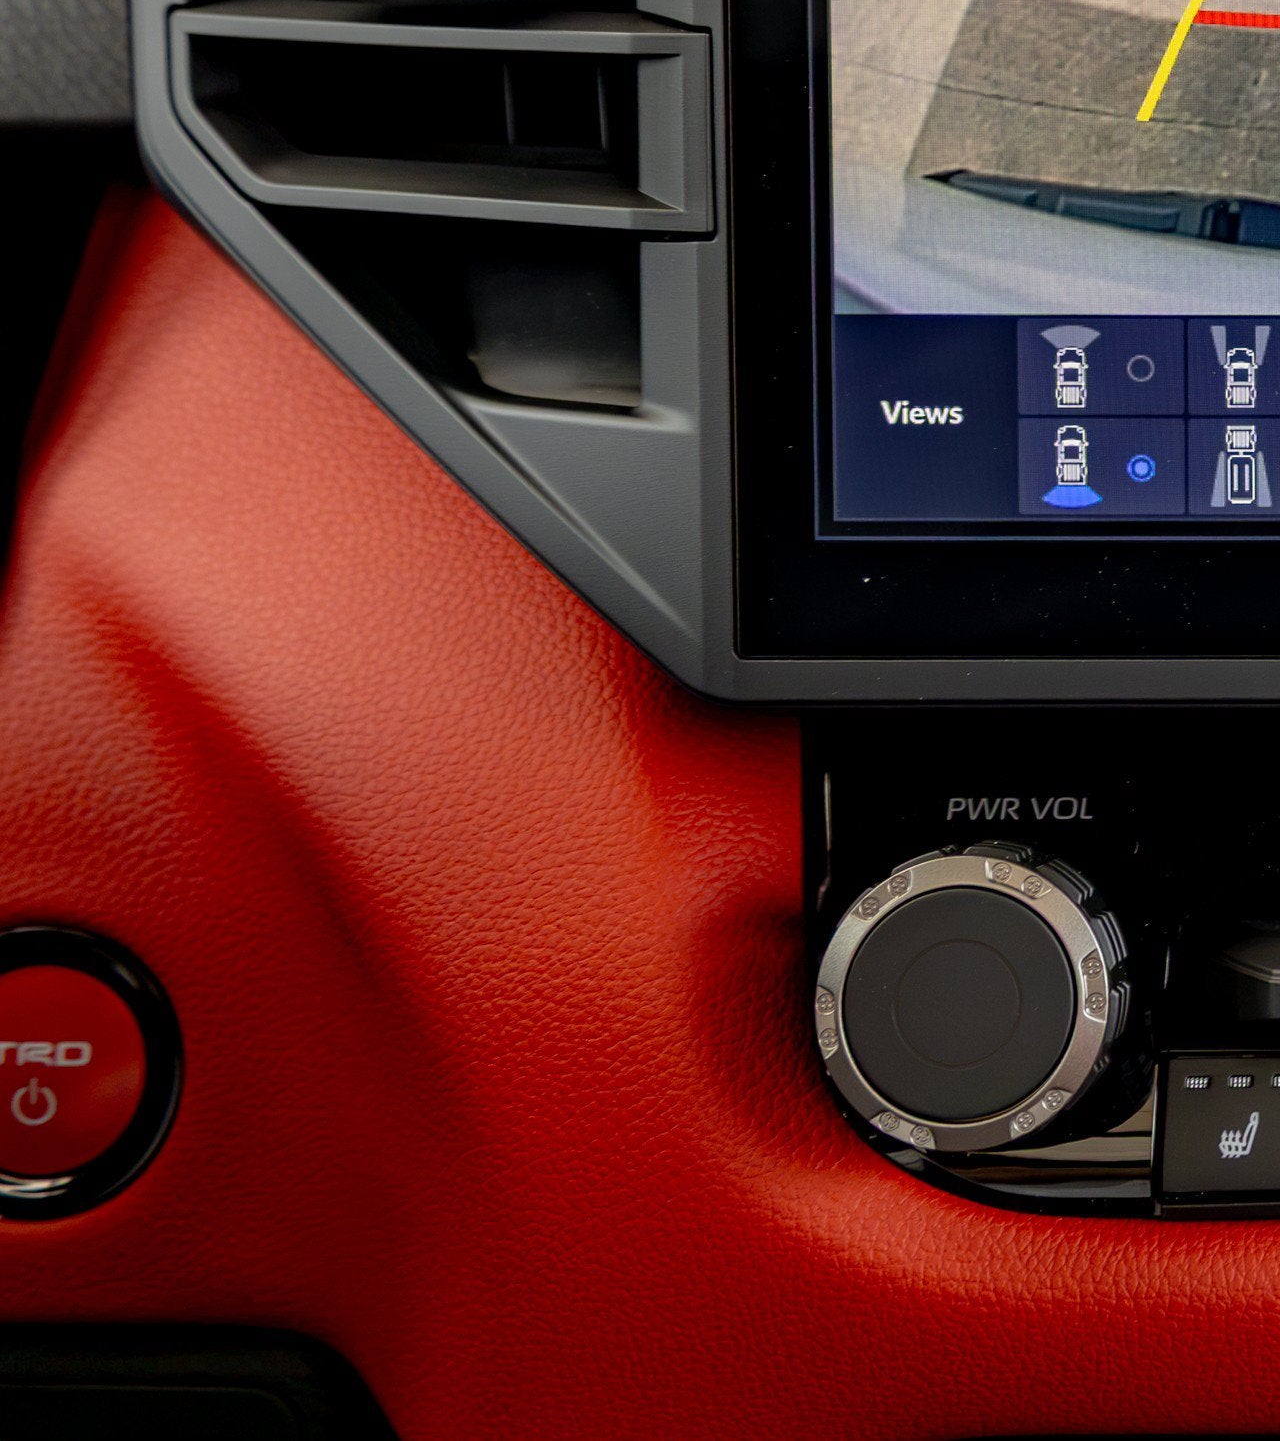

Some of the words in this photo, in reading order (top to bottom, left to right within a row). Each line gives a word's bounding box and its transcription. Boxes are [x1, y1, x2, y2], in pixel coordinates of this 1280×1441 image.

[880, 400, 963, 425] Views
[945, 797, 1020, 821] PWR
[1031, 797, 1094, 820] VOL
